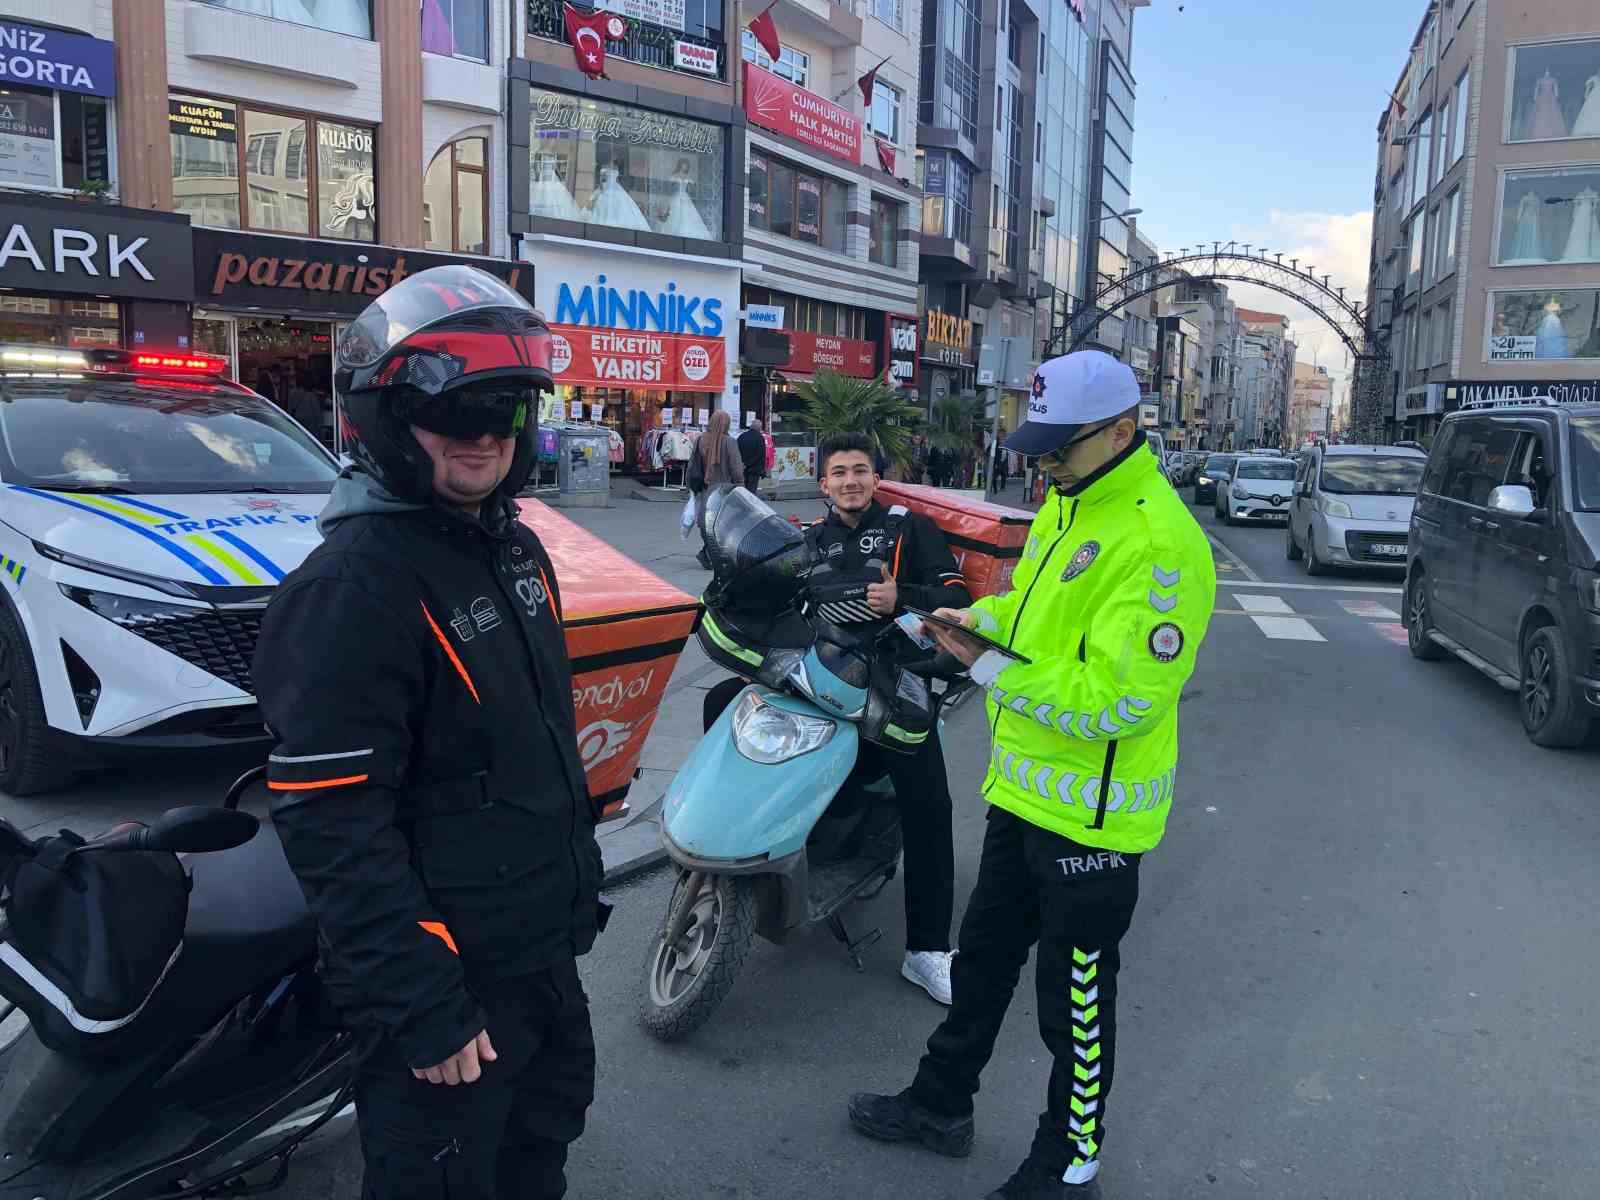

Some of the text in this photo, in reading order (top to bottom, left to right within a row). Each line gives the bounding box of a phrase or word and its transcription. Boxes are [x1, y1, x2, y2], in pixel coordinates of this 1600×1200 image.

[180, 104, 223, 120] KUAFÖR
[790, 109, 818, 132] HALK
[319, 127, 373, 153] KUAFÖR
[556, 274, 723, 337] MİNNİKS
[591, 332, 662, 354] ETİKETİN
[815, 338, 841, 350] MEYDAN
[891, 325, 917, 351] vadi
[891, 360, 914, 378] avm
